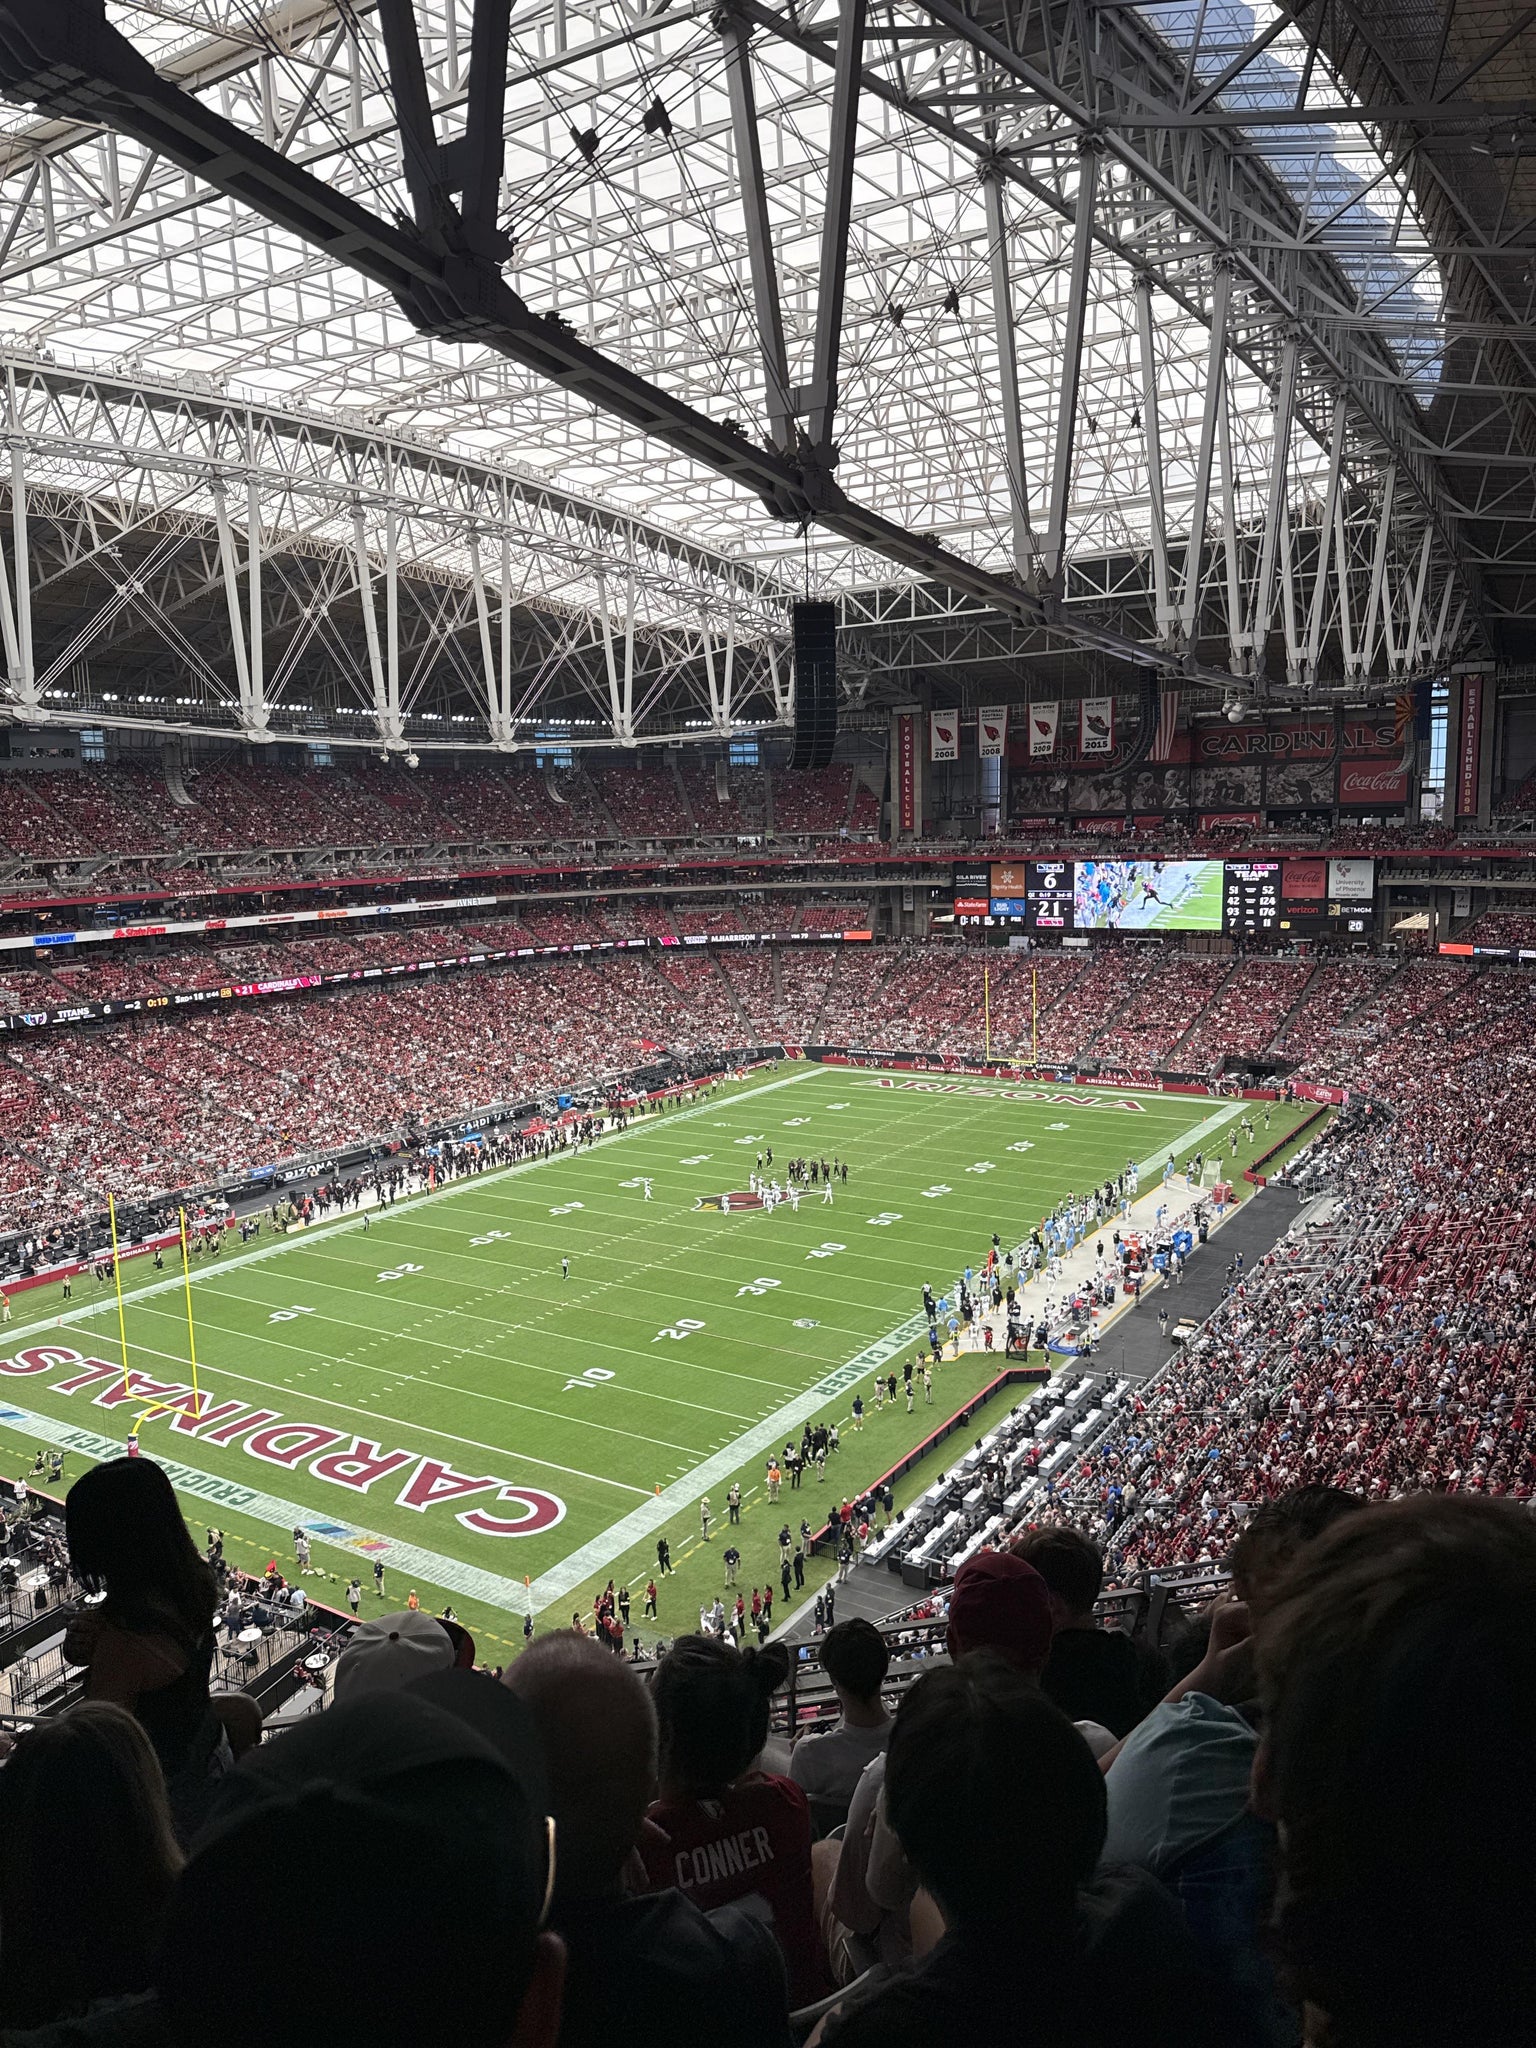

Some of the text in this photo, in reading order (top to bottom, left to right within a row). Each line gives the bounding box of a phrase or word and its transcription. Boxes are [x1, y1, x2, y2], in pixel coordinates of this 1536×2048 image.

[1033, 745, 1052, 753] 2009
[1085, 741, 1108, 749] 2015
[1463, 688, 1476, 813] ESTABLISHED 1898
[981, 748, 1001, 756] 2008
[1343, 771, 1401, 792] Coca-Cola
[1044, 873, 1057, 889] 6
[1284, 871, 1321, 883] Coca-Cola
[1228, 886, 1239, 894] 51
[1262, 886, 1275, 894] 52
[1227, 897, 1240, 905] 42
[1259, 897, 1276, 905] 124
[1038, 900, 1060, 917] 21
[1226, 908, 1240, 916] 93
[1259, 908, 1276, 916] 176
[1229, 918, 1236, 927] 7
[1350, 921, 1362, 930] 20
[711, 934, 755, 942] M.HARRISON
[242, 980, 298, 995] 21 CARDINALS
[147, 997, 168, 1007] 0:19
[193, 992, 204, 1000] 18
[57, 1005, 111, 1018] TITANS 6
[1086, 1078, 1118, 1086] ARIZONA
[850, 1078, 1147, 1112] ARIZONA
[1315, 1090, 1332, 1098] CATCH
[782, 1117, 812, 1126] 20
[1044, 1122, 1071, 1131] 10
[1005, 1141, 1036, 1152] 20
[965, 1161, 997, 1174] 30
[920, 1184, 953, 1198] 40
[865, 1212, 904, 1226] 50
[469, 1230, 512, 1246] 30
[808, 1242, 847, 1259] 40
[377, 1262, 424, 1280] 20
[738, 1277, 782, 1296] 30
[269, 1304, 316, 1322] 10
[656, 1318, 706, 1340] 20
[566, 1367, 616, 1389] 10
[812, 1350, 889, 1396] CANCER
[0, 1345, 568, 1538] CARDINALS
[675, 1826, 775, 1889] CONNER
